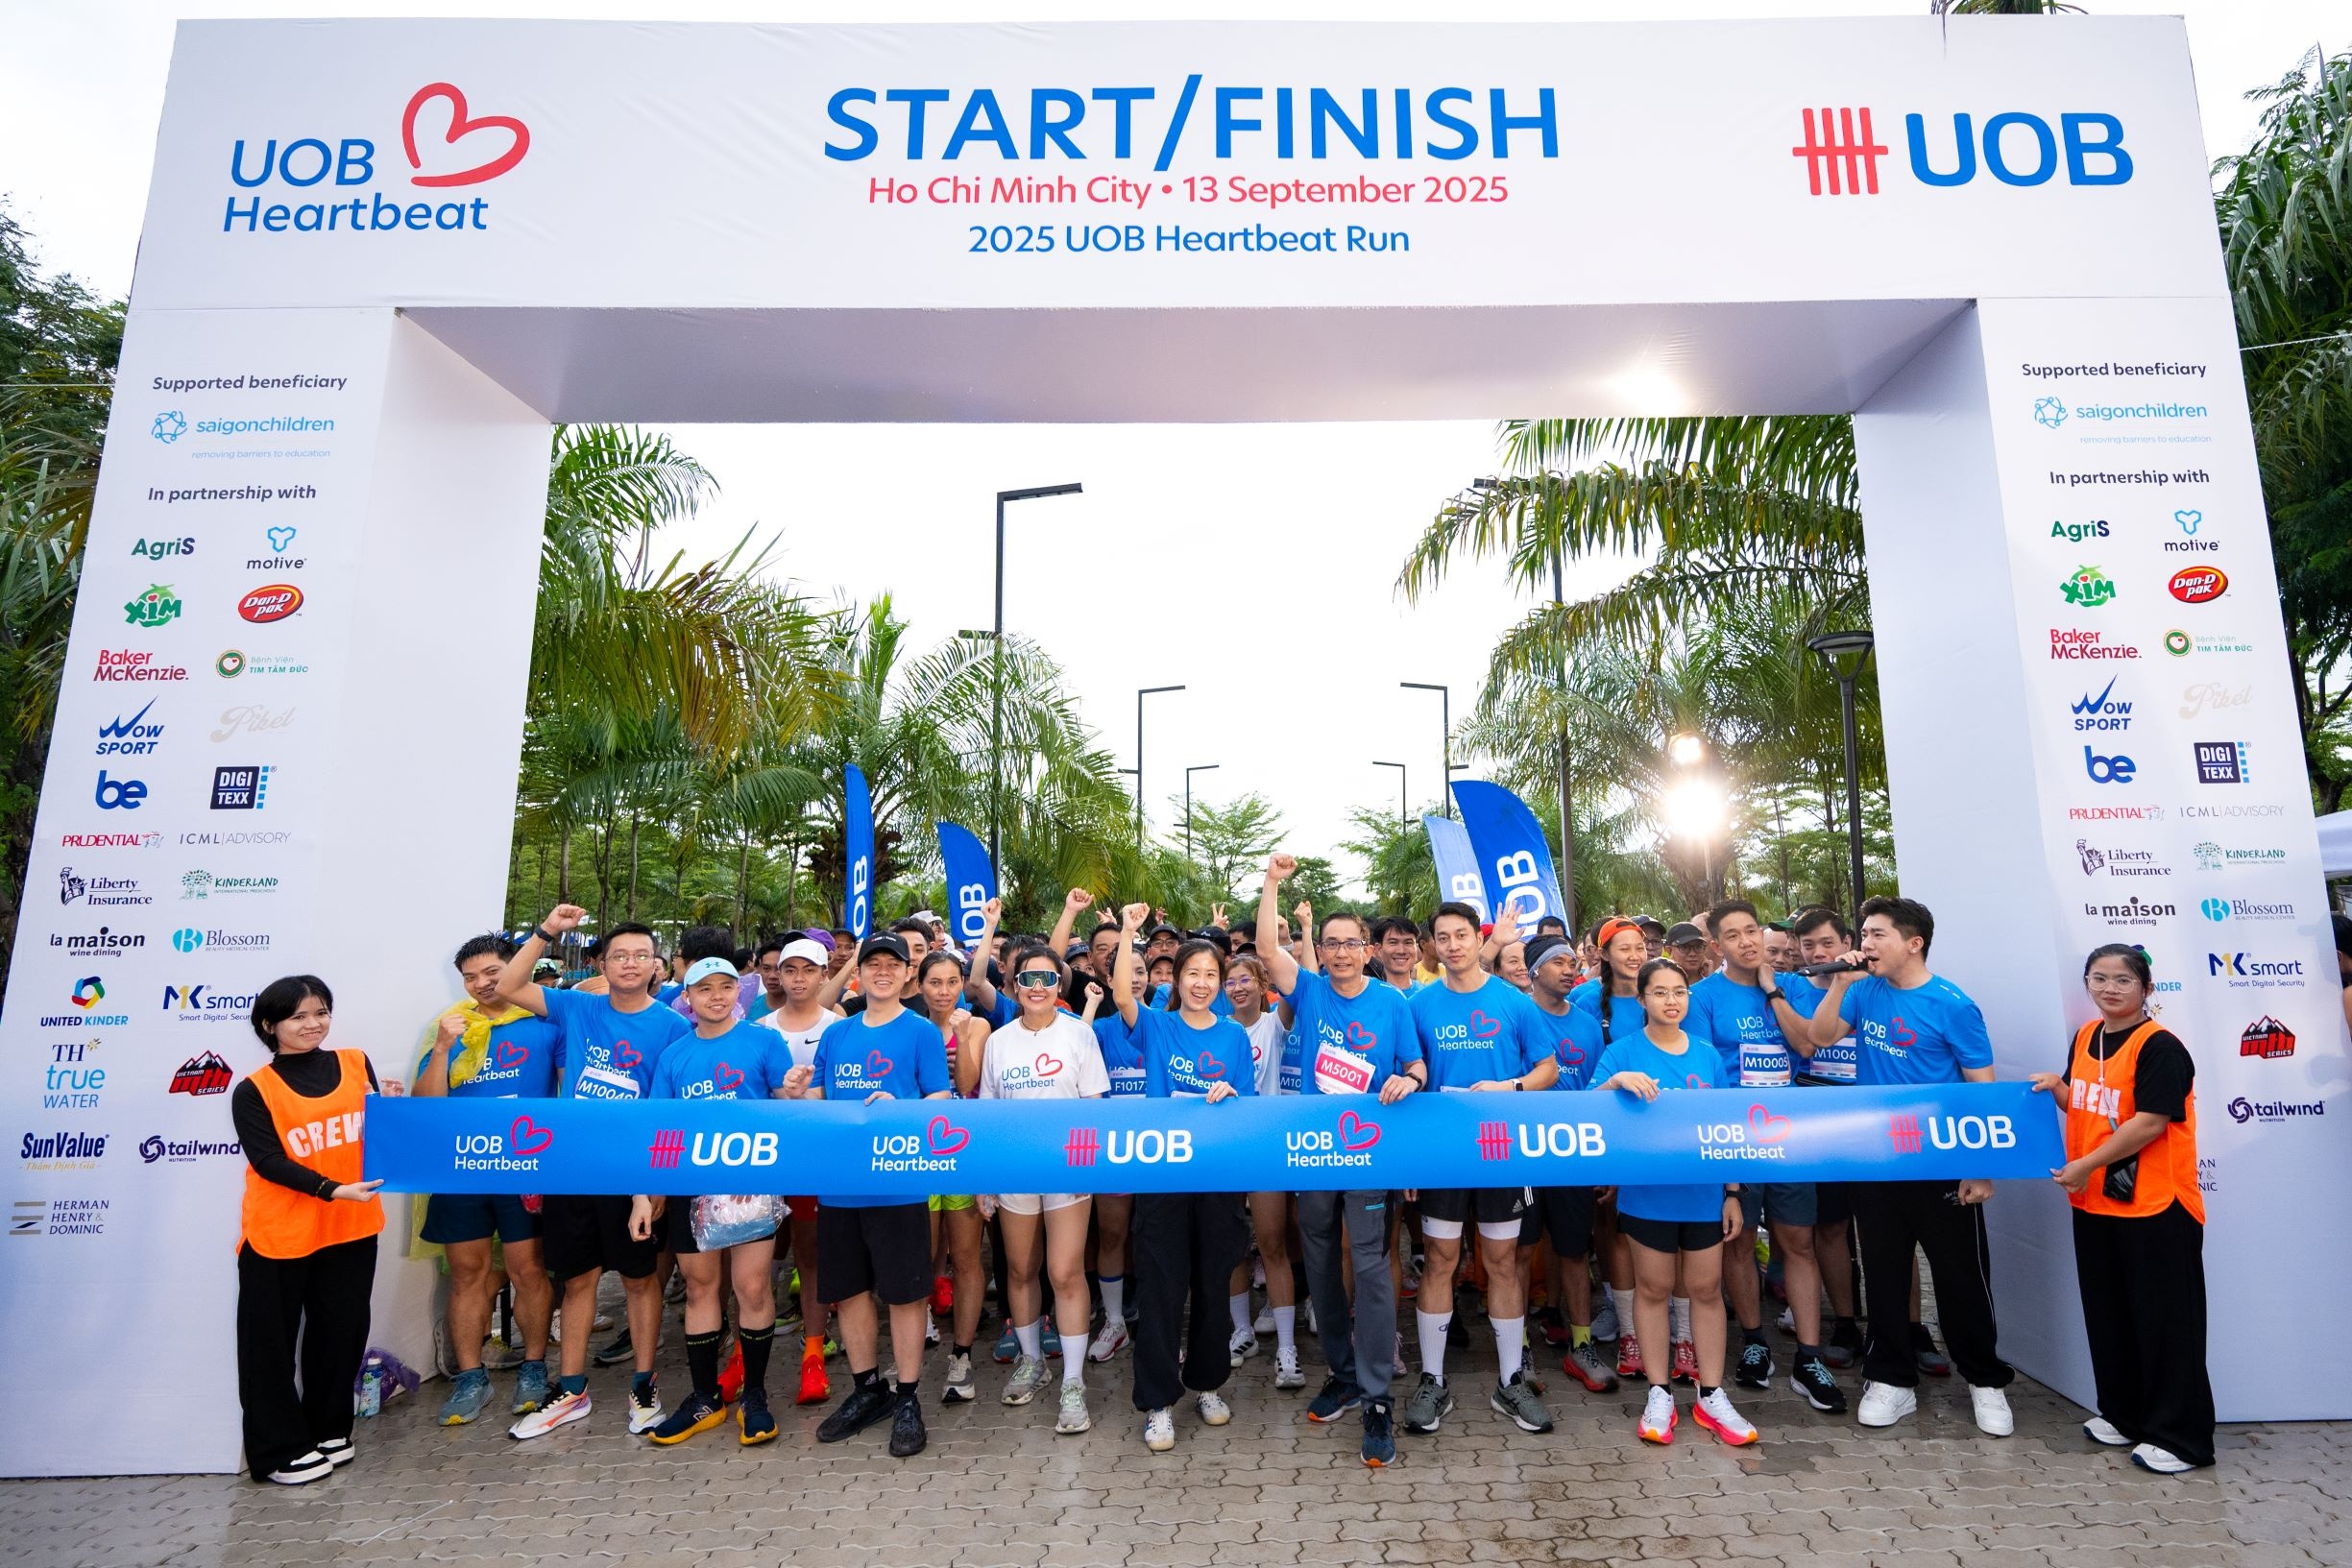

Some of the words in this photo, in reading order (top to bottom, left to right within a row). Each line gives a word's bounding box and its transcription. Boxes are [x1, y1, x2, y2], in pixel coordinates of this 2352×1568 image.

[824, 74, 1559, 172] START/FINISH
[1905, 112, 2133, 186] UOB
[230, 138, 375, 187] UOB
[869, 177, 917, 204] Ho
[927, 176, 981, 204] Chi
[991, 176, 1076, 204] Minh
[1086, 176, 1152, 209] City
[1183, 176, 1219, 203] 13
[1228, 176, 1416, 209] September
[1423, 177, 1508, 203] 2025
[223, 194, 489, 232] Heartbeat
[968, 226, 1055, 253] 2025
[1065, 225, 1145, 253] UOB
[1155, 225, 1337, 252] Heartbeat
[1346, 227, 1410, 252] Run
[2023, 363, 2109, 378] Supported
[2113, 362, 2206, 378] beneficiary
[153, 375, 245, 393] Supported
[249, 375, 347, 393] beneficiary
[2076, 403, 2207, 421] saigonchildren
[196, 417, 334, 435] saigonchildren
[274, 449, 283, 458] to
[285, 449, 330, 458] education
[2049, 471, 2065, 485] In
[2070, 470, 2168, 488] partnership
[2172, 470, 2209, 484] with
[148, 487, 164, 501] In
[168, 486, 273, 503] partnership
[277, 485, 317, 499] with
[2050, 520, 2110, 543] AgriS
[131, 537, 196, 561] AgriS
[2165, 539, 2219, 551] motive
[247, 557, 304, 569] motive
[2186, 584, 2212, 596] pak
[254, 602, 284, 618] pak
[2050, 628, 2100, 643] Baker
[99, 649, 153, 665] Baker
[2051, 644, 2142, 659] McKenzie.
[93, 665, 189, 682] McKenzie.
[2074, 718, 2131, 731] SPORT
[96, 742, 158, 755] SPORT
[2199, 747, 2231, 763] DIGI
[2084, 745, 2136, 784] be
[2202, 765, 2235, 780] TEXX
[218, 772, 253, 788] DIGI
[96, 770, 147, 809] be
[217, 790, 250, 806] TEXX
[2070, 808, 2146, 819] PRUDENTIAL
[62, 834, 141, 847] PRUDENTIAL
[2108, 849, 2152, 863] Liberty
[2225, 849, 2286, 858] KINDERLAND
[2110, 866, 2171, 876] Insurance
[89, 878, 138, 893] Liberty
[214, 877, 279, 888] KINDERLAND
[87, 895, 153, 905] Insurance
[2085, 903, 2097, 915] la
[2102, 896, 2175, 916] maison
[2233, 900, 2293, 914] Blossom
[49, 933, 63, 947] la
[67, 927, 145, 948] maison
[206, 929, 270, 946] Blossom
[95, 949, 122, 958] dining
[2251, 960, 2303, 976] smart
[2152, 982, 2182, 991] NDER
[40, 1016, 83, 1026] UNITED
[85, 1015, 129, 1025] KINDER
[204, 1013, 228, 1023] Digital
[1736, 1017, 1763, 1029] UOB
[1319, 1020, 1344, 1044] UOB
[1435, 1025, 1467, 1040] UOB
[52, 1044, 85, 1062] TH
[1438, 1039, 1494, 1051] Heartbeat
[1745, 1057, 1787, 1068] M10005
[1815, 1049, 1856, 1060] M1006
[46, 1064, 106, 1090] true
[835, 1064, 861, 1077] UOB
[1001, 1066, 1031, 1081] UOB
[1321, 1060, 1363, 1085] M5001
[196, 1085, 225, 1095] SERIES
[682, 1080, 714, 1098] UOB
[1003, 1078, 1055, 1091] Heartbeat
[43, 1094, 99, 1108] WATER
[2071, 1078, 2121, 1119] REW
[2255, 1100, 2324, 1116] tailwind
[287, 1111, 366, 1158] CREW
[1286, 1131, 1333, 1150] UOB
[1518, 1122, 1606, 1157] UOB
[1697, 1124, 1745, 1144] UOB
[1928, 1115, 2016, 1150] UOB
[21, 1132, 106, 1159] SunValue
[167, 1140, 240, 1156] tailwind
[456, 1135, 502, 1154] UOB
[691, 1132, 778, 1167] UOB
[872, 1136, 920, 1154] UOB
[1107, 1129, 1193, 1164] UOB
[1700, 1145, 1785, 1160] Heartbeat
[454, 1155, 539, 1171] Heartbeat
[871, 1156, 957, 1172] Heartbeat
[1287, 1150, 1371, 1168] Heartbeat
[53, 1200, 109, 1210] HERMAN
[51, 1212, 92, 1222] HENRY
[95, 1213, 104, 1221] &
[49, 1224, 104, 1235] DOMINIC
